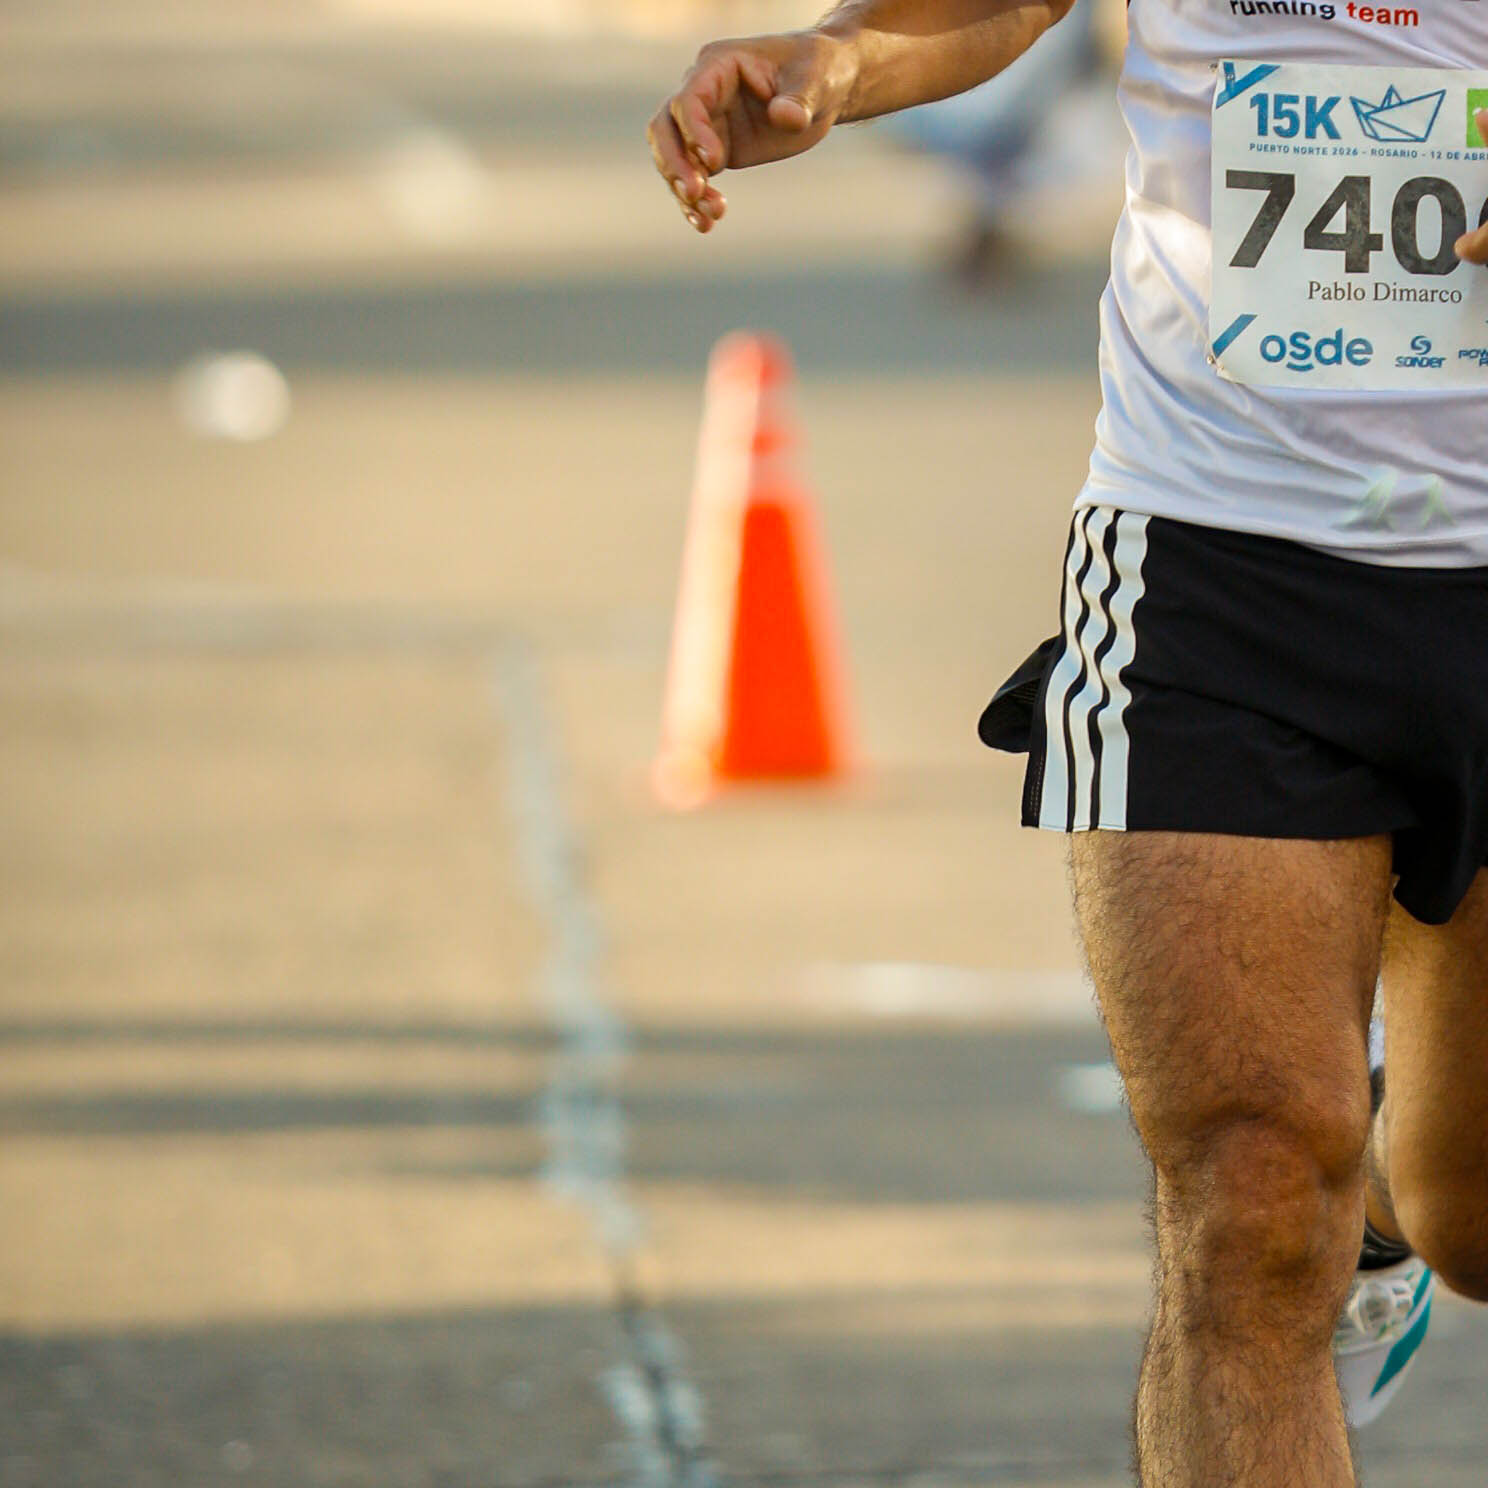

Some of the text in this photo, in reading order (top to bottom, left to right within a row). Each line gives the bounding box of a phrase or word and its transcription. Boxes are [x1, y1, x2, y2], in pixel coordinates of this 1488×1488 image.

[1346, 2, 1419, 26] team
[1249, 92, 1342, 140] 15K
[1249, 143, 1290, 153] PUERTO
[1293, 146, 1328, 155] NORTE
[1371, 148, 1418, 158] ROSARIO
[1431, 151, 1442, 160] 12
[1446, 151, 1460, 160] DE
[1307, 280, 1463, 304] Pablo Dimarco
[1259, 327, 1374, 366] osde
